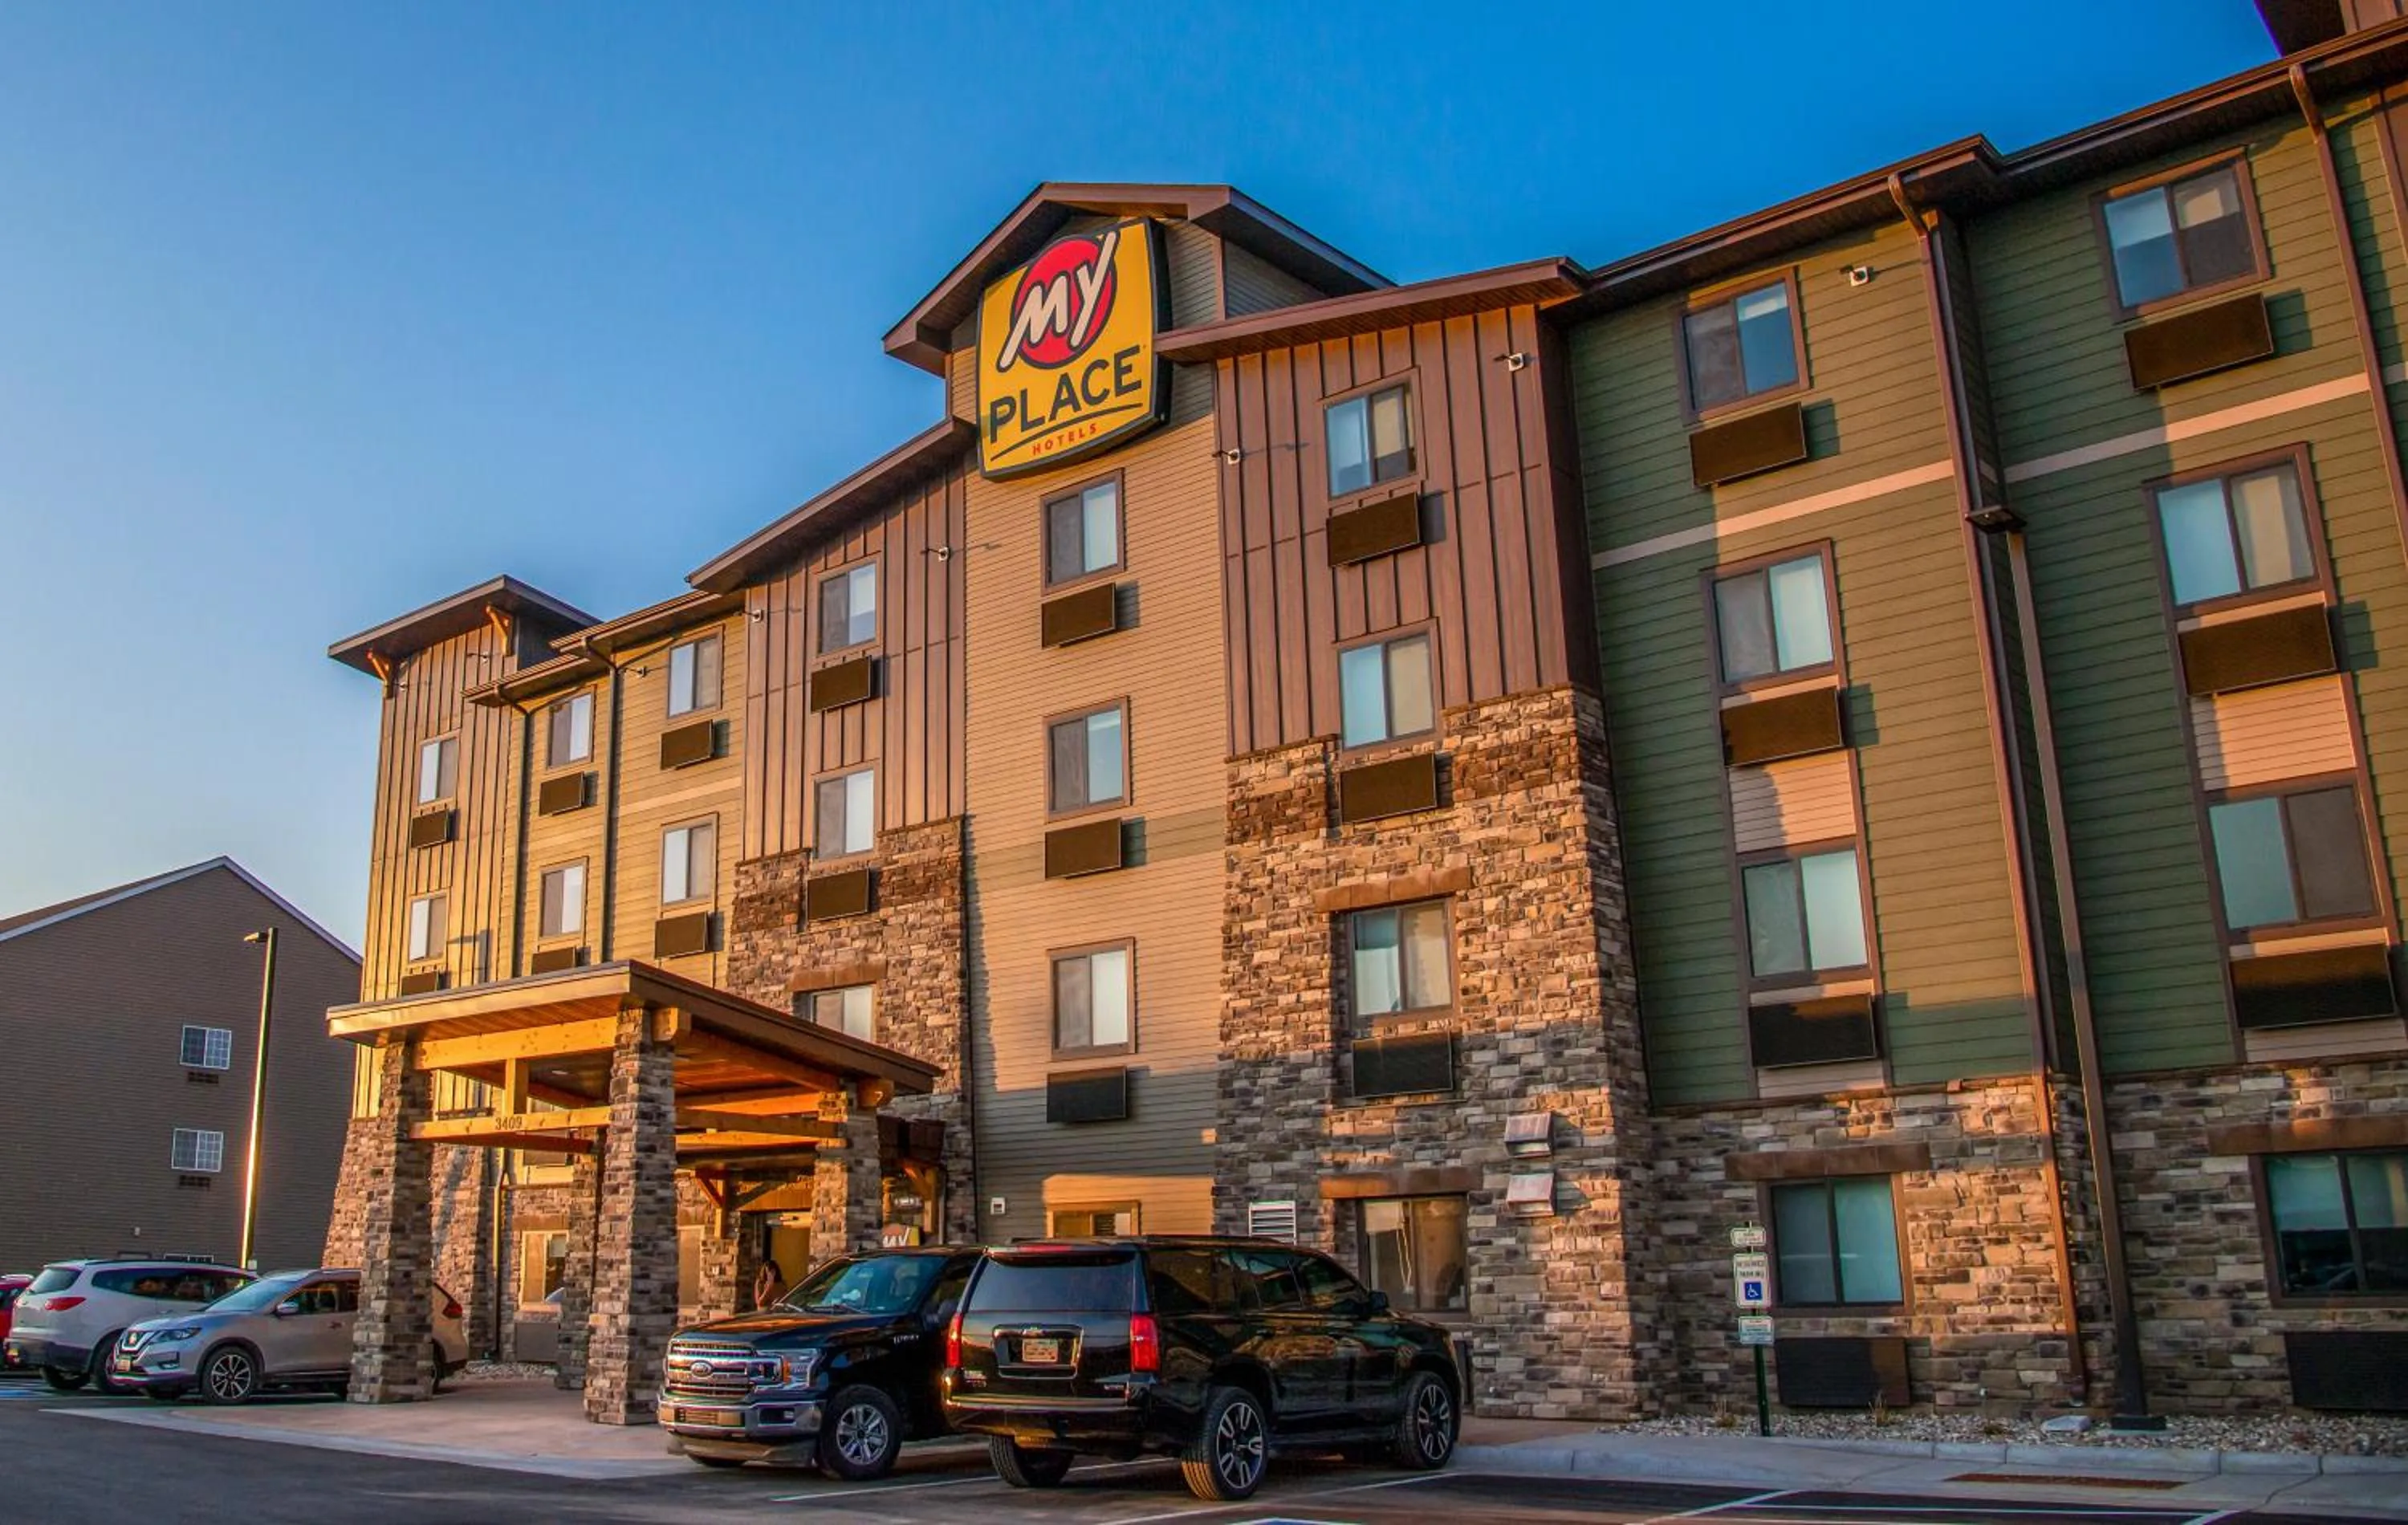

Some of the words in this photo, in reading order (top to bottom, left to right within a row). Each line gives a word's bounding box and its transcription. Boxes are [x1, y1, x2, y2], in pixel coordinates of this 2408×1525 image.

[989, 344, 1142, 445] PLACE
[1032, 423, 1098, 456] HOTELS
[494, 1116, 523, 1131] 3409
